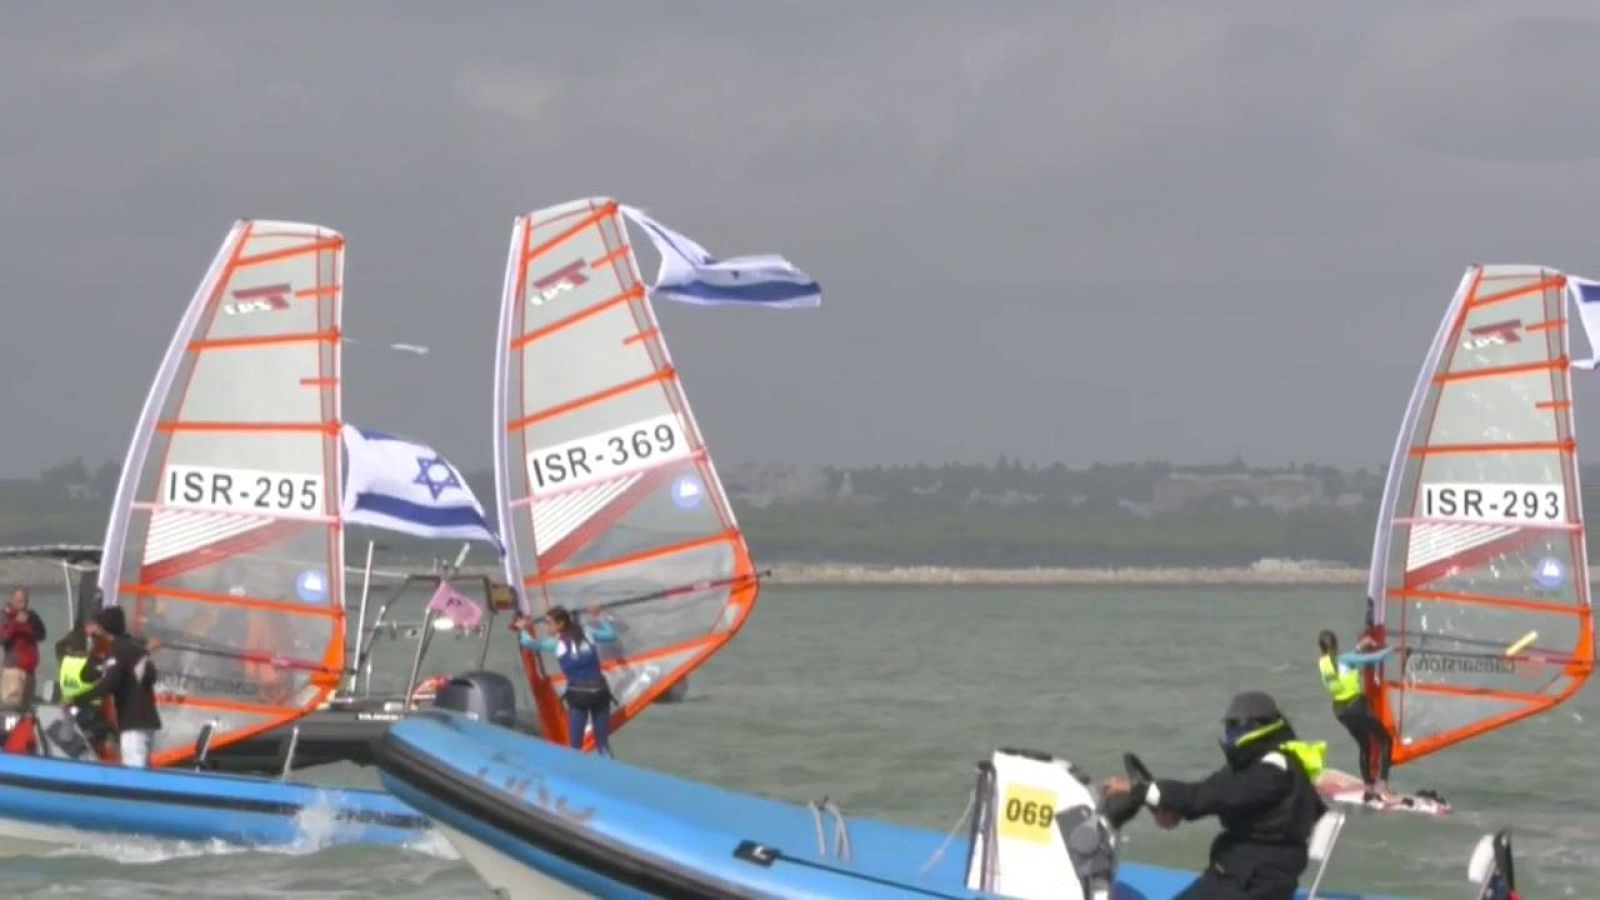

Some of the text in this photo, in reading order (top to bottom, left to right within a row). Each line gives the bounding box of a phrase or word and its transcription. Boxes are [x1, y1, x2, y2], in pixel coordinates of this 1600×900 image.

[531, 424, 676, 487] ISR-369
[169, 471, 317, 510] ISR-295
[1427, 488, 1560, 519] ISR-293
[1006, 798, 1054, 828] 069
